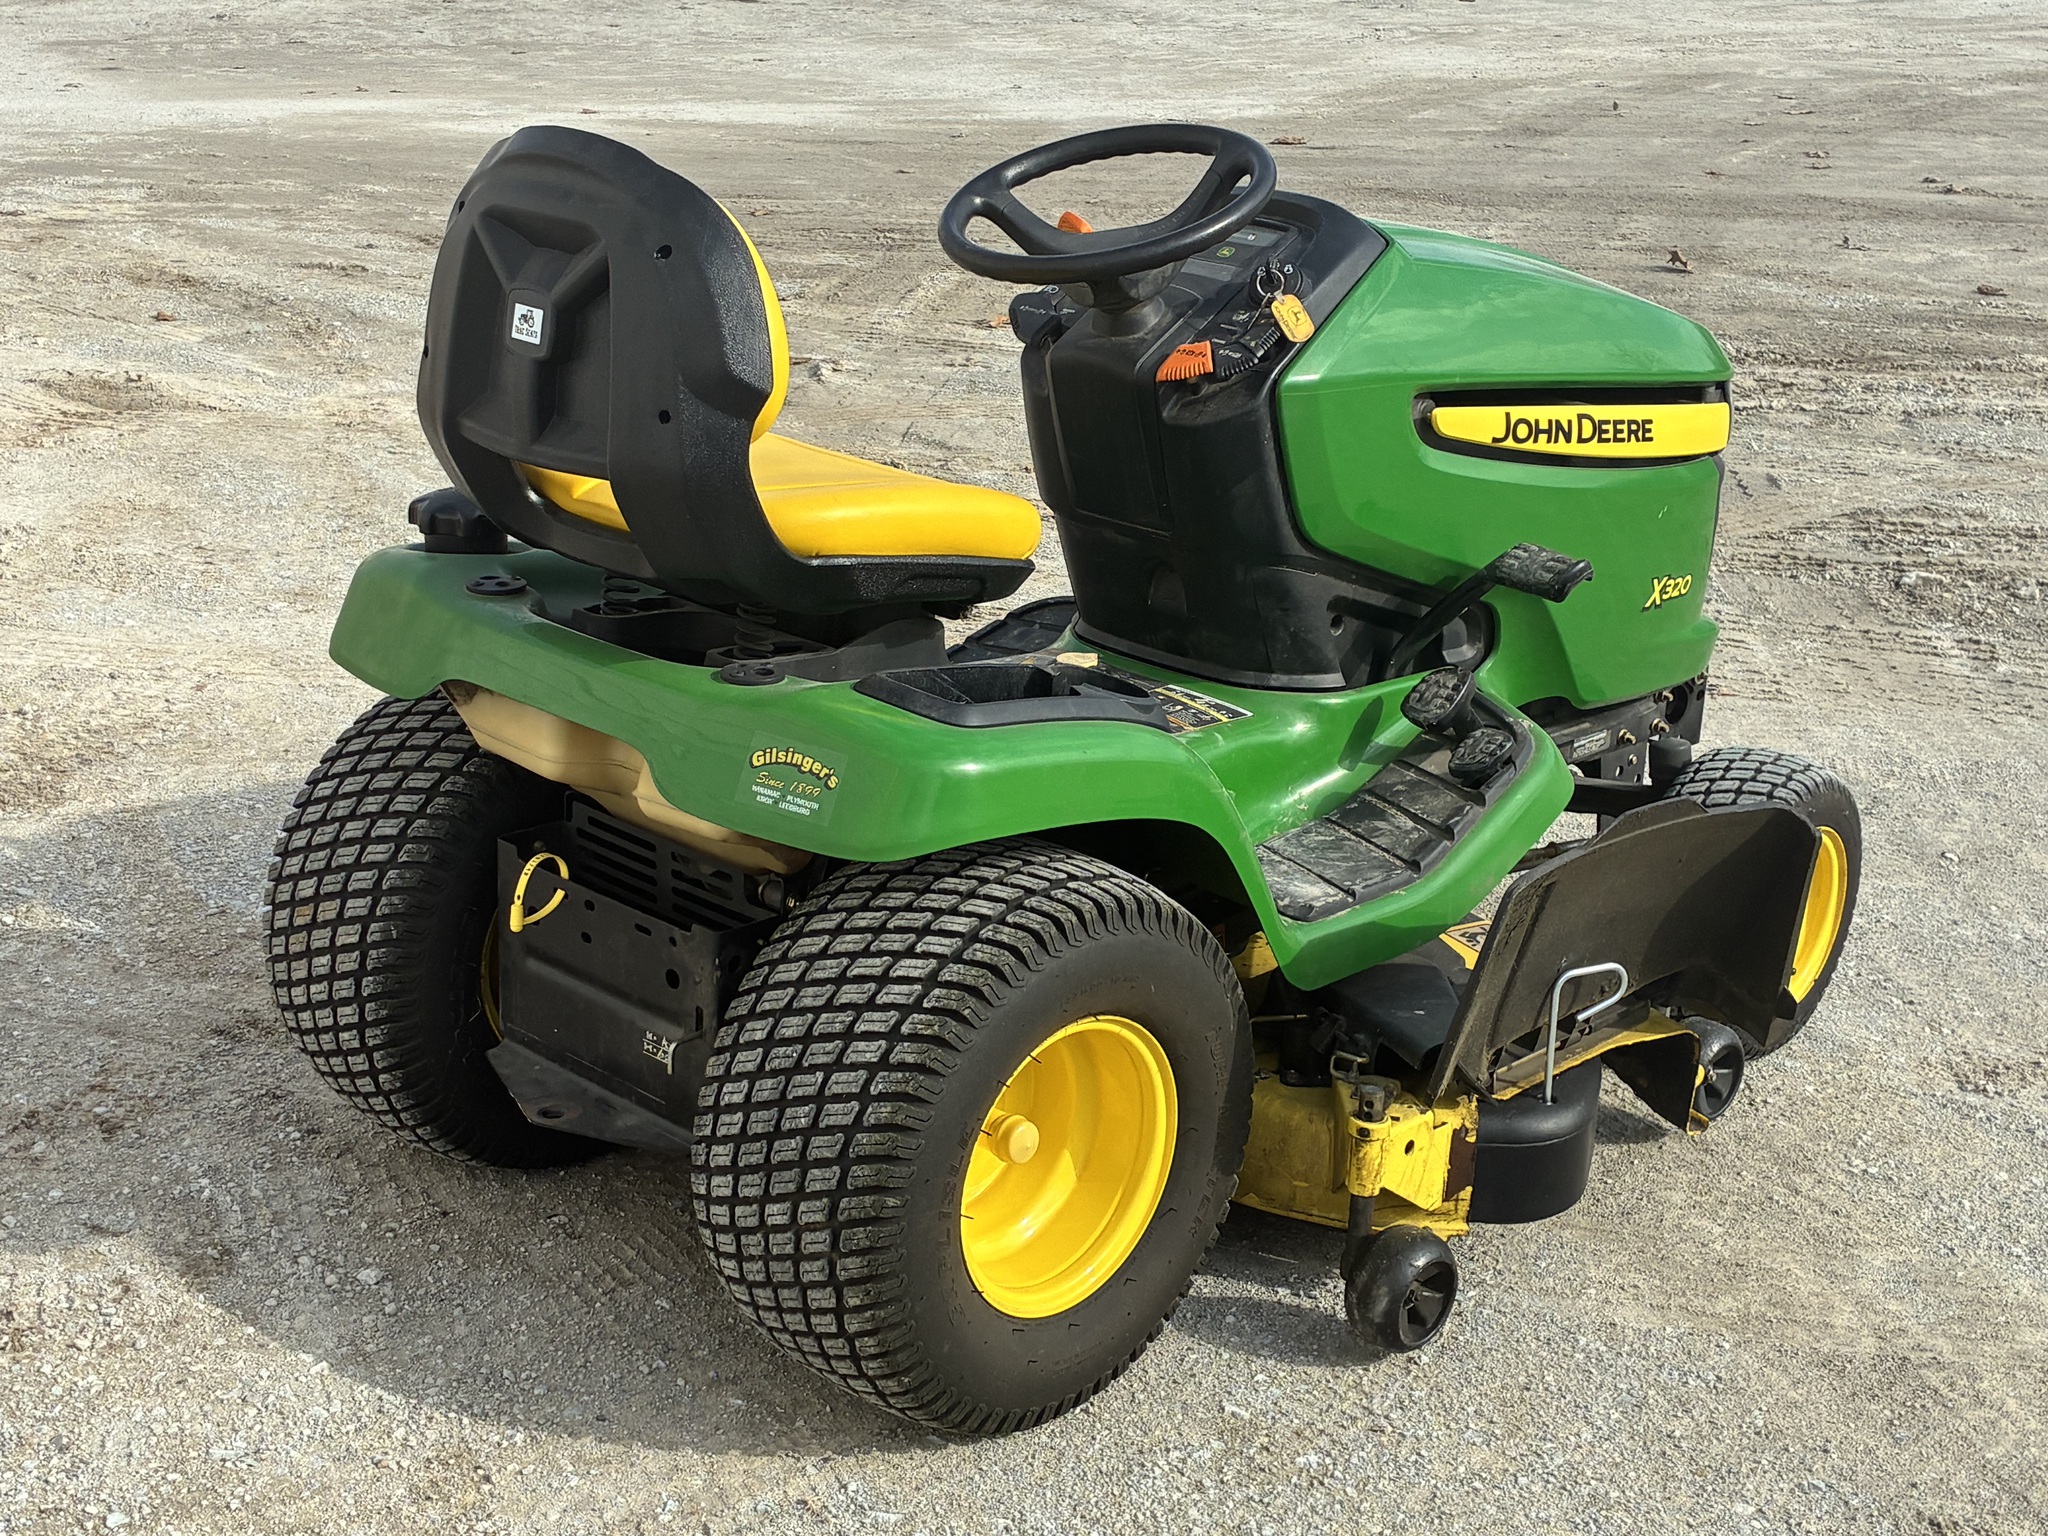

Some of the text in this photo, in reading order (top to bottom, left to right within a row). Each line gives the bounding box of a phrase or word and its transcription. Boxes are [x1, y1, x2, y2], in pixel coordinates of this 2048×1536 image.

[1491, 411, 1654, 444] JOHN DEERE
[1642, 573, 1692, 609] X320
[750, 747, 840, 790] Gilsinger's
[756, 771, 822, 797] Since 1899
[786, 794, 820, 811] PLYMOUTH
